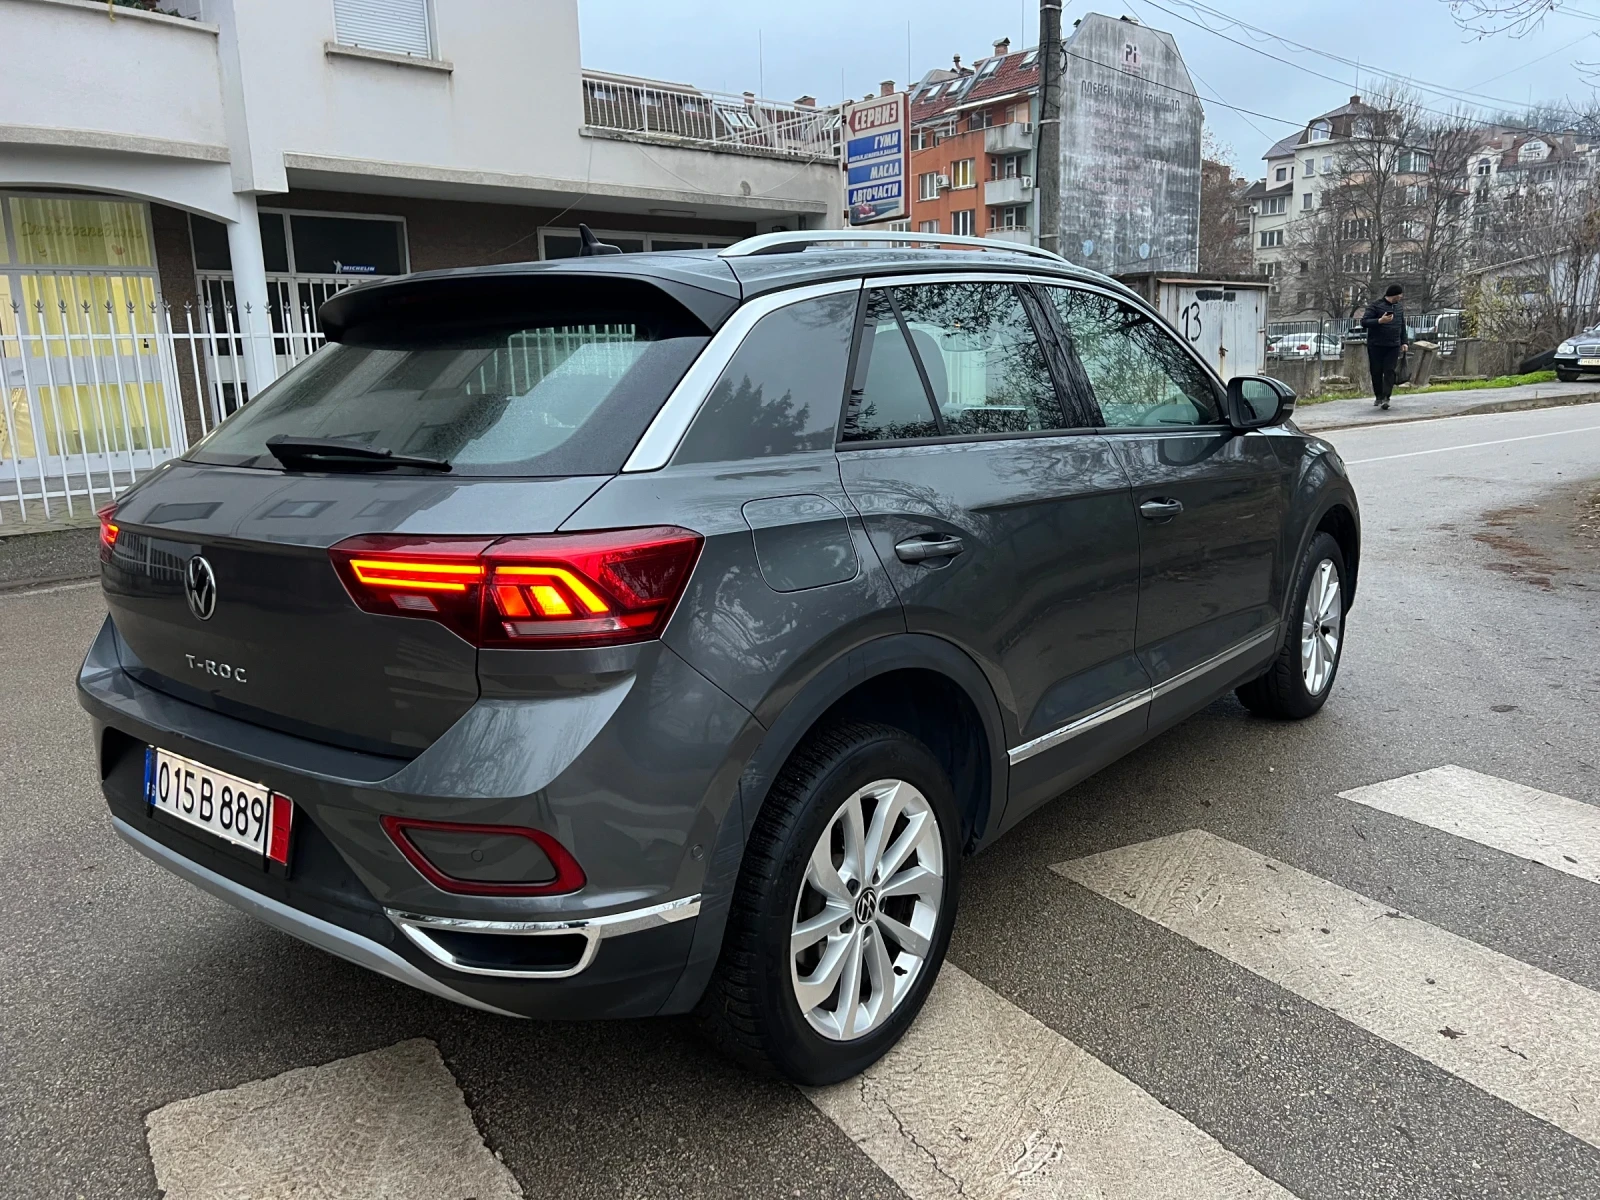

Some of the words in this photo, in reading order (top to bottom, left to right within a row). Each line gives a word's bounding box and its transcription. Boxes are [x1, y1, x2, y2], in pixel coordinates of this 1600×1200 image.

[854, 102, 898, 130] СЕРВИЗ
[874, 131, 898, 149] ГУМИ
[870, 162, 899, 180] МАСЛА
[852, 183, 898, 203] АВТОЧАСТИ
[1182, 301, 1202, 342] 13
[185, 653, 247, 683] T-ROC
